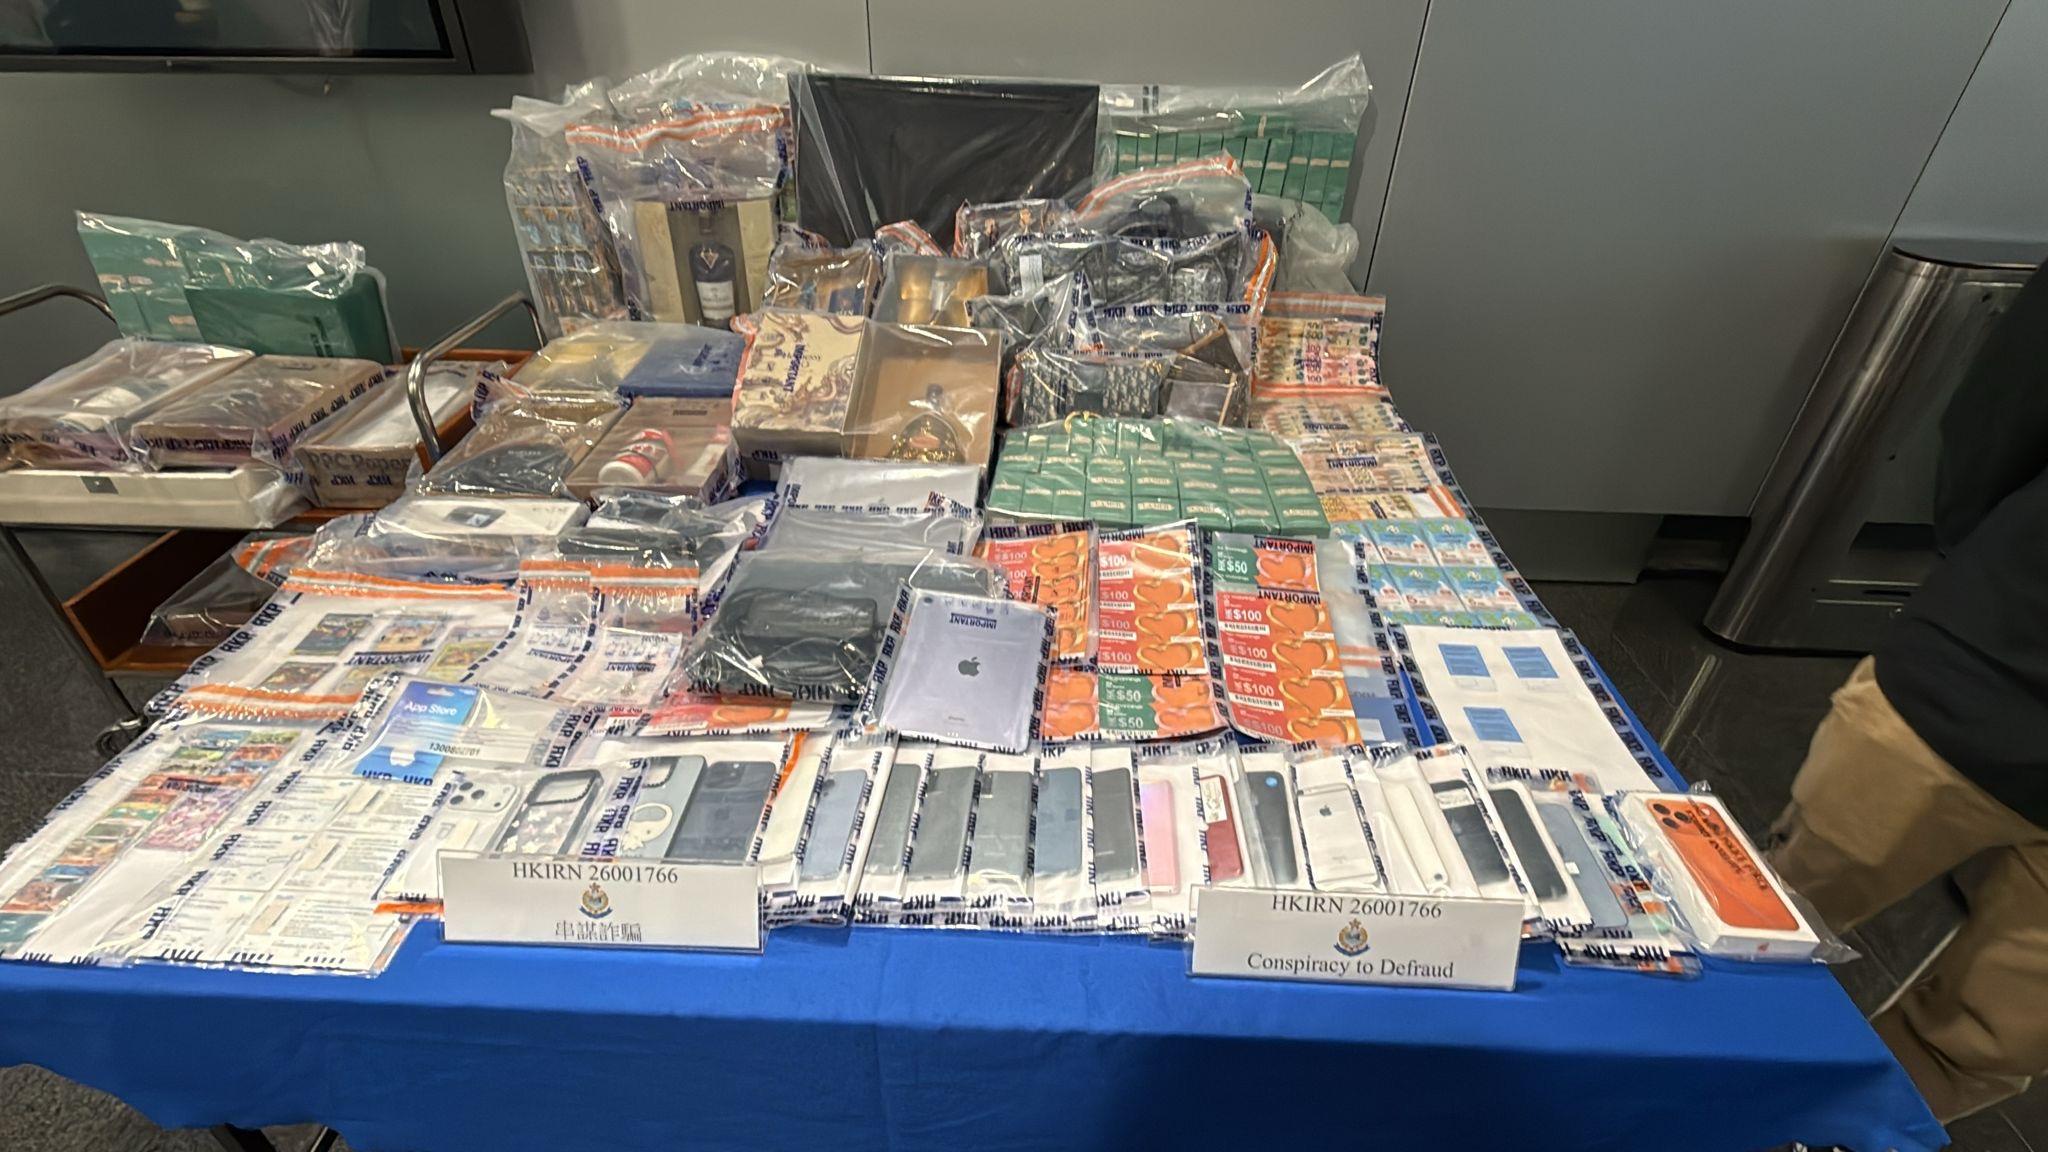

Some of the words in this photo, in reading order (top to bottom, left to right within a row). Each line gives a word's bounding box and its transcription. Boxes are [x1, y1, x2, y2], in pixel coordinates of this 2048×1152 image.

[1254, 537, 1315, 555] IMPORTANT
[1226, 559, 1248, 574] $50
[1258, 588, 1321, 605] IMPORTANT
[949, 613, 997, 630] IMPORTANT
[1233, 608, 1262, 621] $100
[346, 651, 432, 666] IMPORTANT
[404, 701, 427, 713] App
[428, 703, 458, 717] Store
[513, 862, 582, 881] HKIRN
[588, 865, 679, 884] 26001766
[1272, 895, 1344, 914] HKIRN
[1349, 898, 1442, 919] 26001766
[555, 919, 642, 943] 串謀詐騙
[1247, 952, 1351, 978] Conspiracy
[1356, 959, 1374, 975] to
[1380, 958, 1454, 979] Defraud
